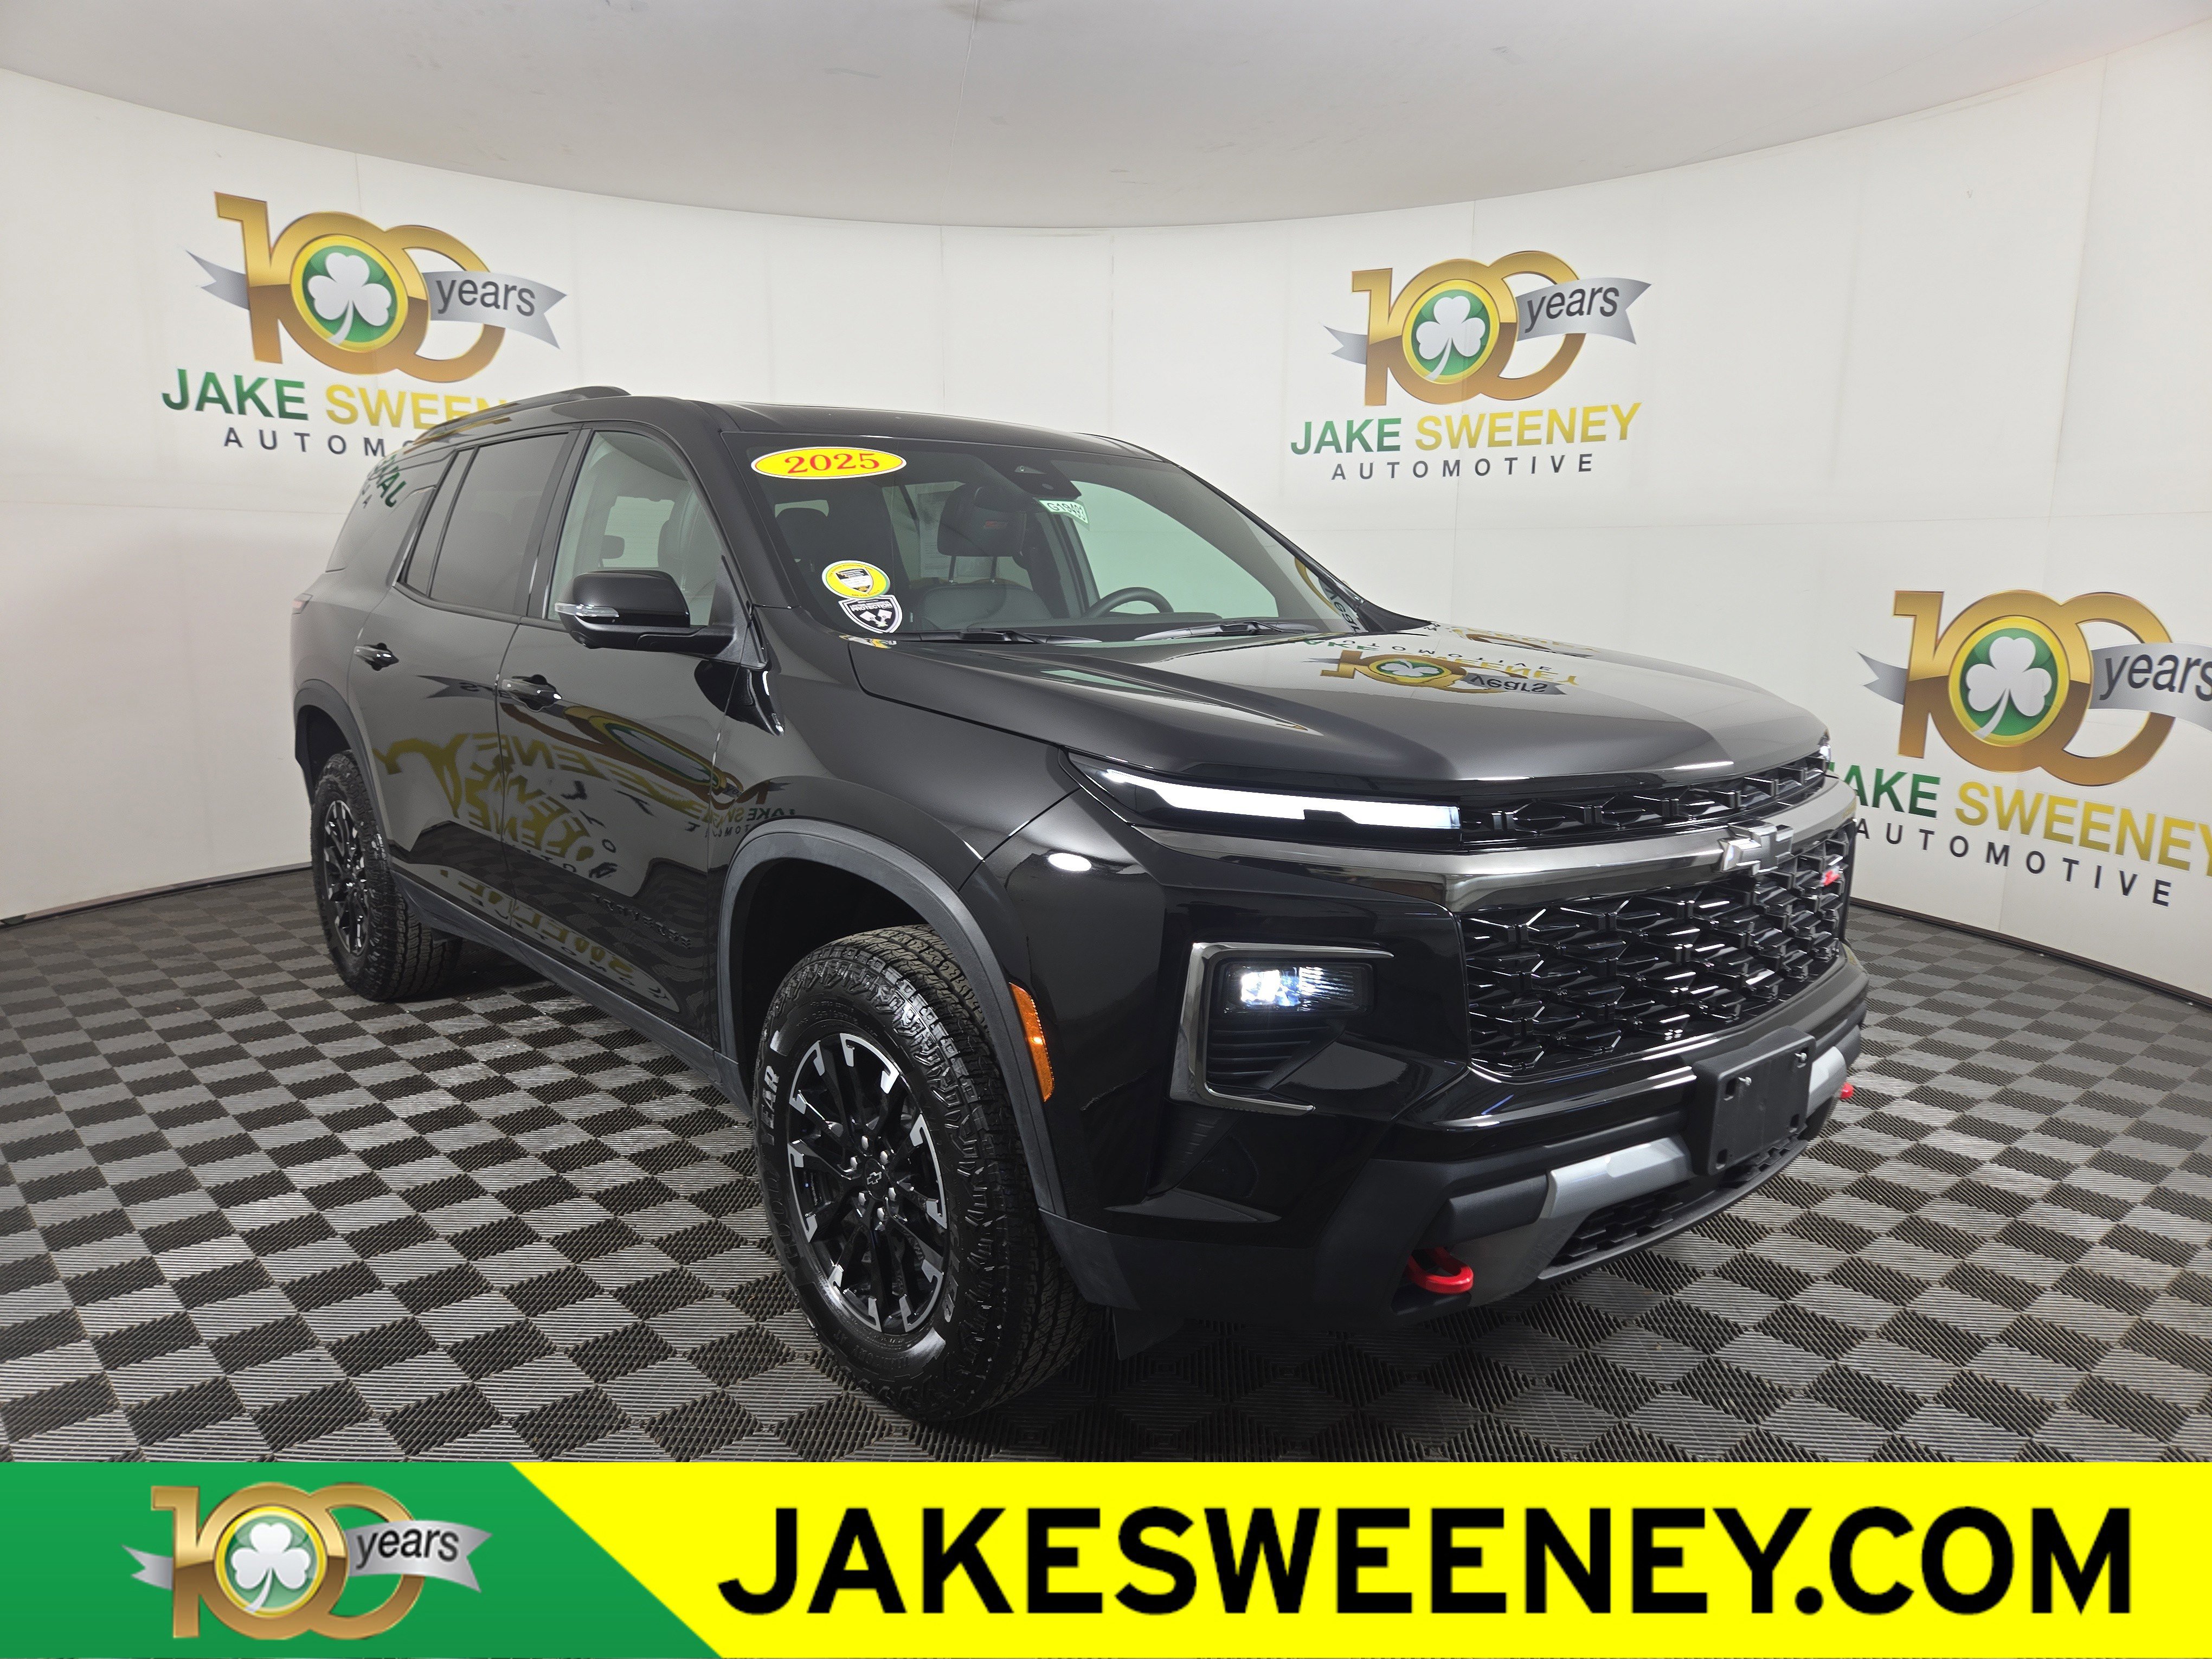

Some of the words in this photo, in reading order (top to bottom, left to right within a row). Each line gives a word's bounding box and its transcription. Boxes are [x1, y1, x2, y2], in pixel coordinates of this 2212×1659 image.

[436, 278, 536, 317] years
[1524, 285, 1619, 333] years
[161, 368, 309, 421] JAKE
[325, 384, 507, 430] SWEE
[223, 427, 415, 458] AUTOM
[1290, 417, 1402, 456] JAKE
[1414, 402, 1643, 452] SWEENEY
[785, 453, 880, 474] 2025
[1330, 453, 1593, 481] AUTOMOTIVE
[2099, 654, 2212, 702] years
[1828, 761, 1941, 819] AKE
[1856, 818, 2172, 907] AUTOMOTIVE
